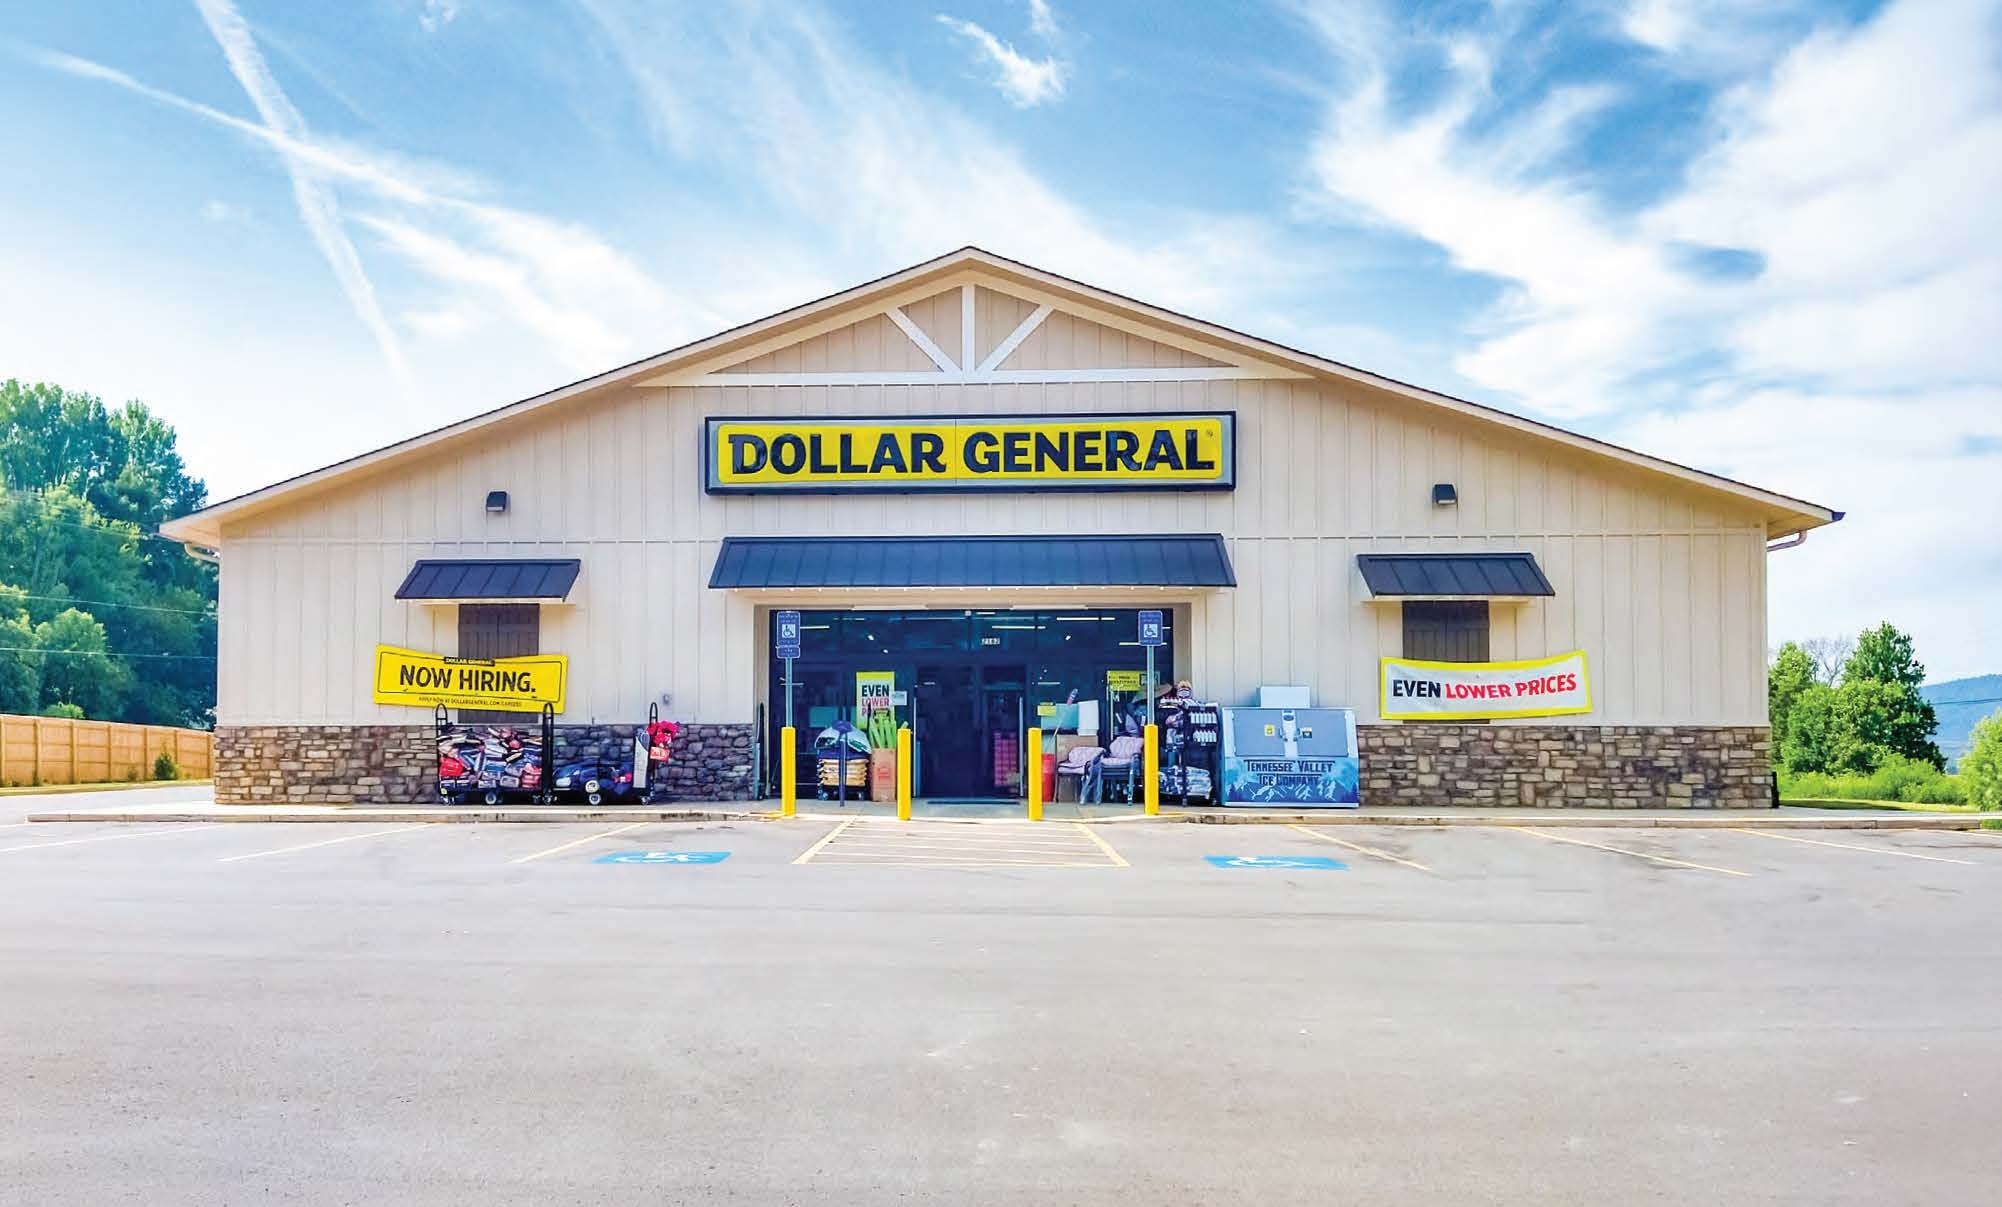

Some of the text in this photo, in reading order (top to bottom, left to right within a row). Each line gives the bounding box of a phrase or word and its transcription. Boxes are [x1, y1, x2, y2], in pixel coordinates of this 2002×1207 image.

[728, 429, 1215, 475] DOLLAR GENERAL
[400, 664, 536, 693] NOW HIRING.
[1393, 673, 1577, 700] EVEN LOWER PRICES
[861, 683, 890, 697] EVEN
[861, 697, 890, 707] LOWER
[1244, 759, 1336, 773] TENNESSEE VALLEY
